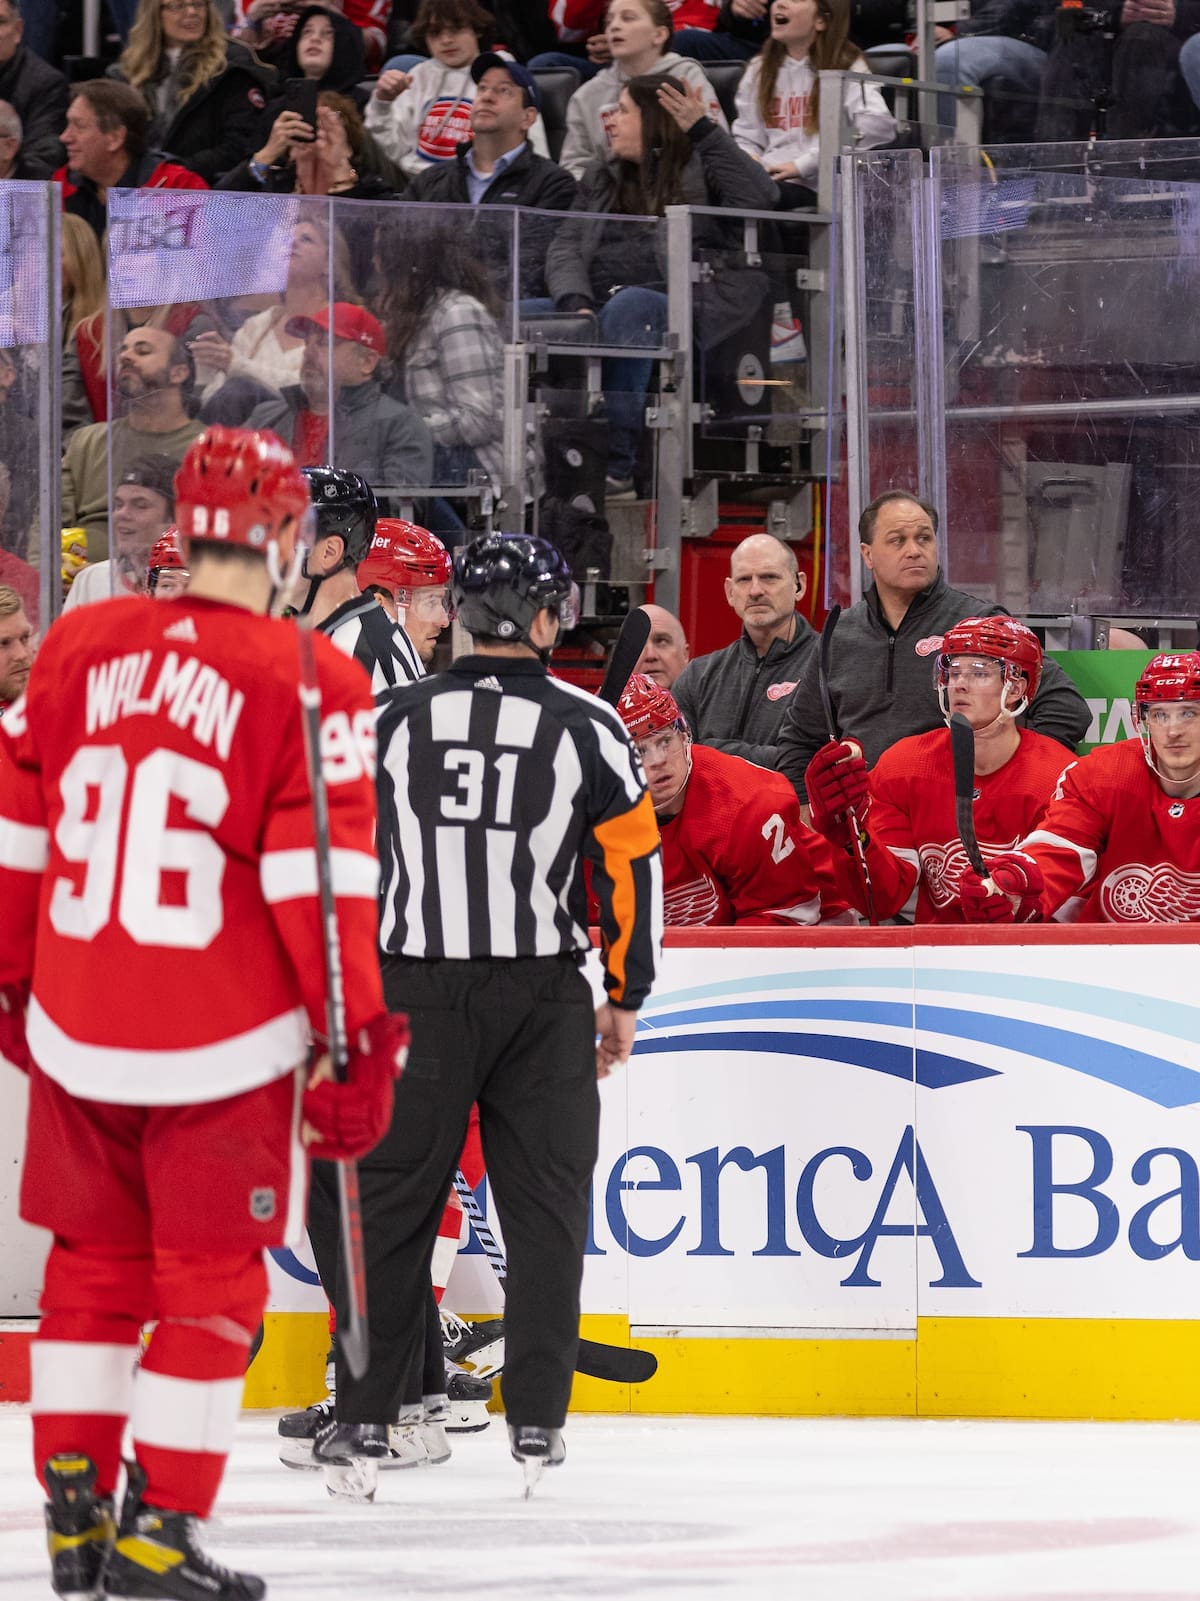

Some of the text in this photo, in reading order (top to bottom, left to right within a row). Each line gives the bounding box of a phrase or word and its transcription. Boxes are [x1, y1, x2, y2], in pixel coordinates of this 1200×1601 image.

[86, 650, 245, 762] WALMAN
[621, 695, 635, 710] 2
[1155, 677, 1186, 687] CCM
[440, 748, 520, 825] 31
[49, 745, 231, 951] 96
[761, 813, 796, 865] 2
